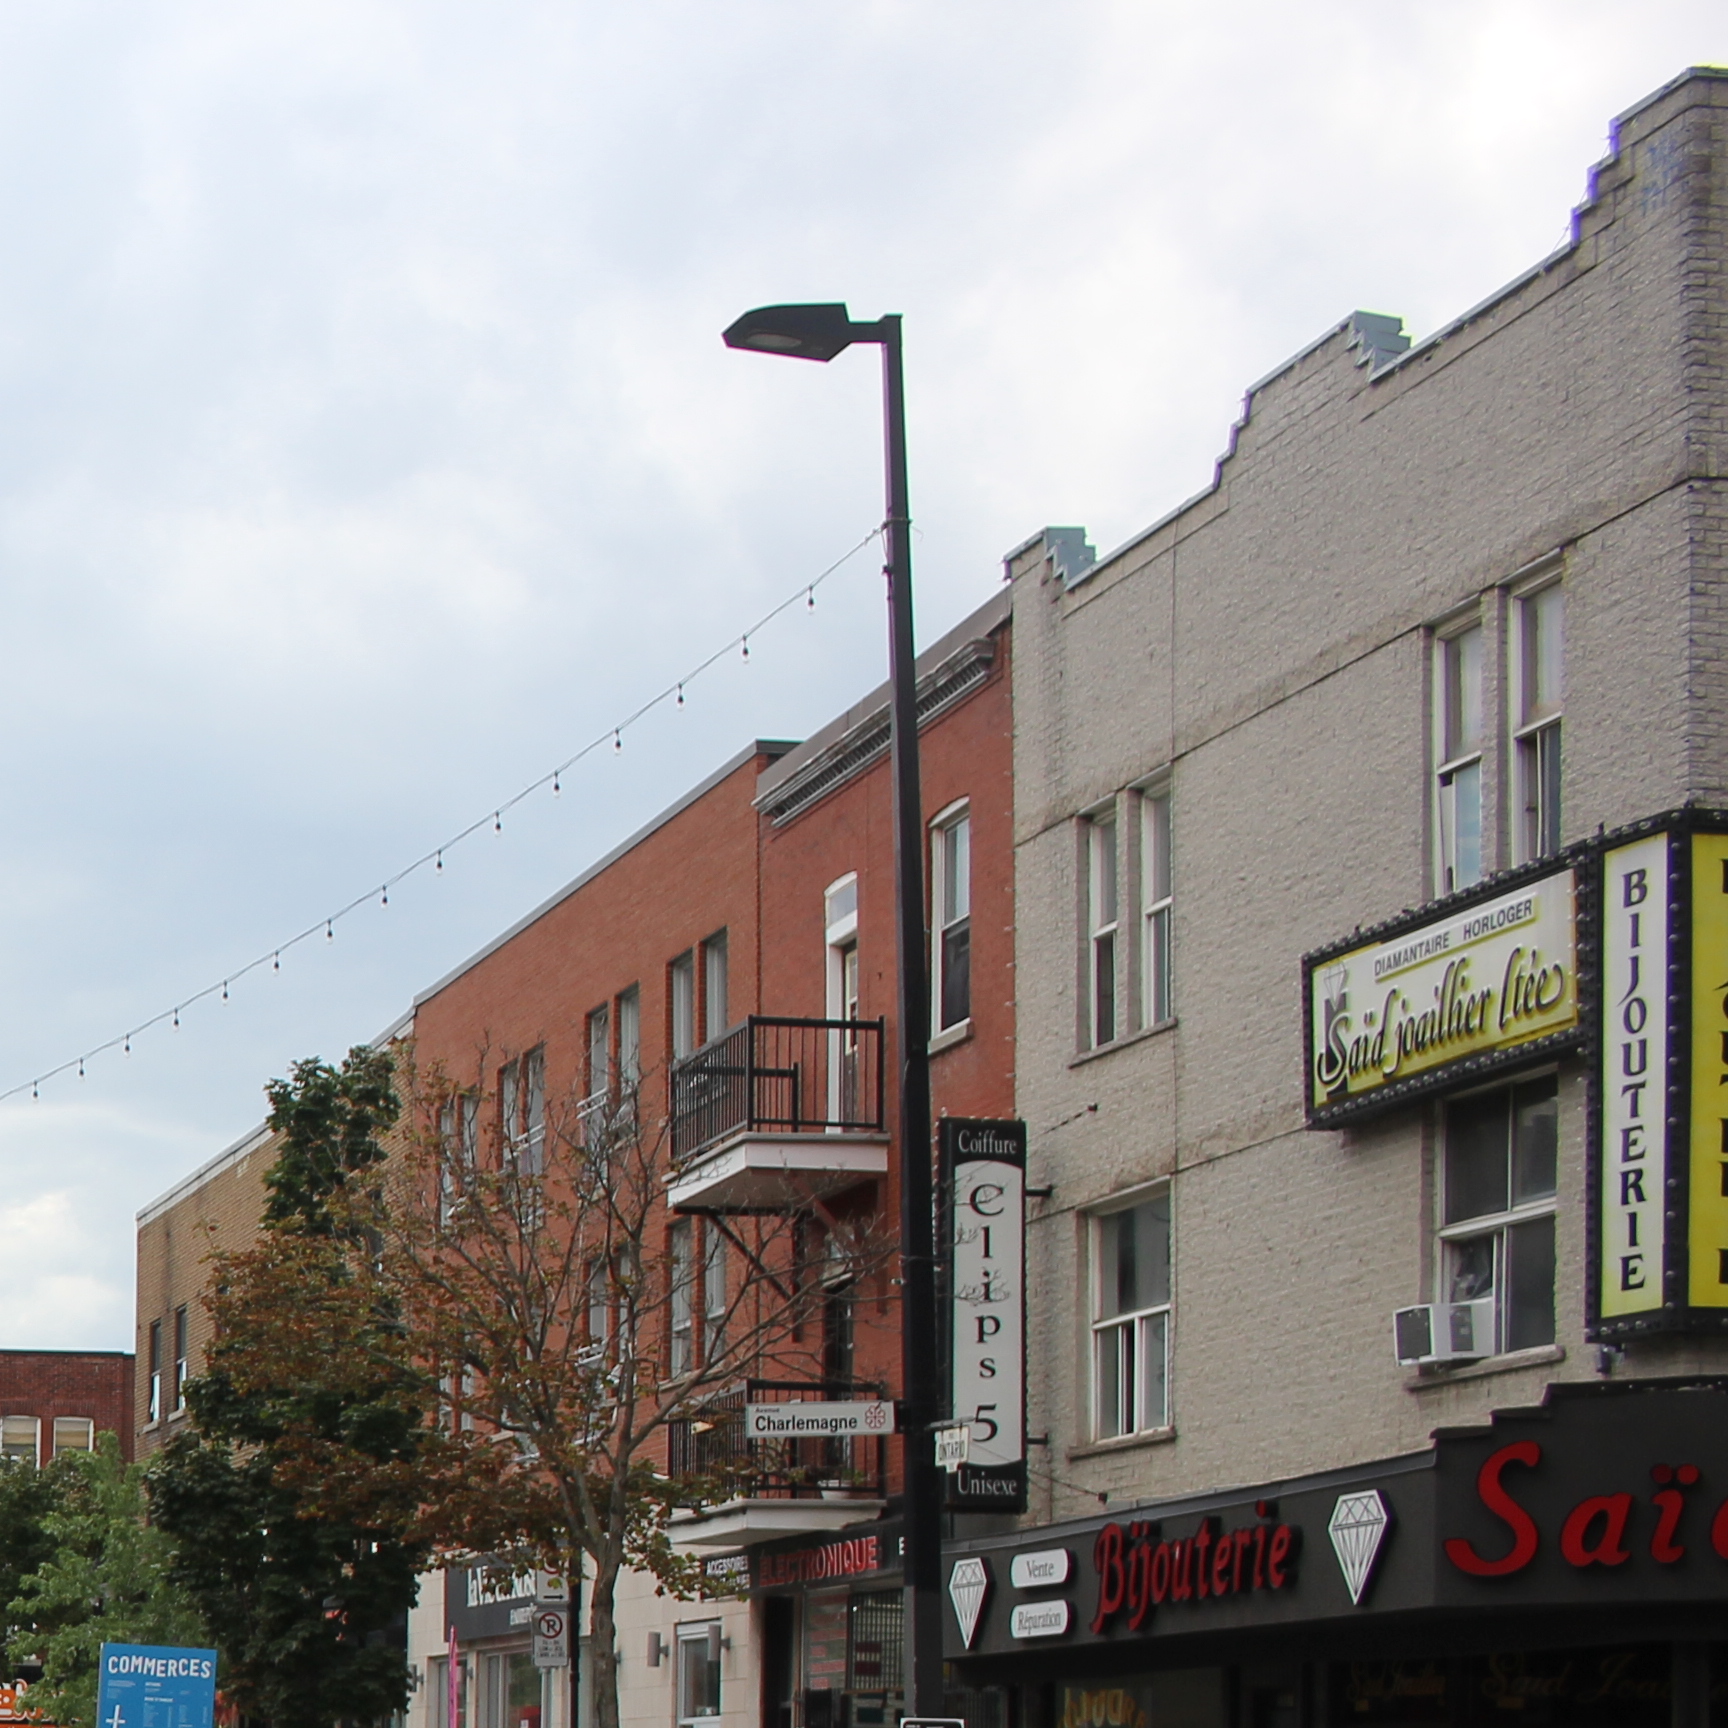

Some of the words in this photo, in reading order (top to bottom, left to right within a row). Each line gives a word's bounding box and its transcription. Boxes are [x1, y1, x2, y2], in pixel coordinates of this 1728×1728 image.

[1374, 931, 1450, 977] DIAMANTAIRE
[1463, 899, 1533, 942] HORLOGER
[1317, 989, 1397, 1085] Saïd
[1615, 868, 1648, 1291] BIJOUTERIE
[958, 1129, 1018, 1155] Coiffure
[755, 1415, 858, 1432] Charlemagne
[972, 1403, 998, 1443] 5
[957, 1469, 1018, 1496] Unisexe
[759, 1535, 879, 1587] ÉLECTRONIQUE
[1026, 1560, 1054, 1578] Vente
[1090, 1500, 1292, 1635] Bijouterie
[1018, 1608, 1061, 1635] Réparation
[108, 1655, 212, 1679] COMMERCES
